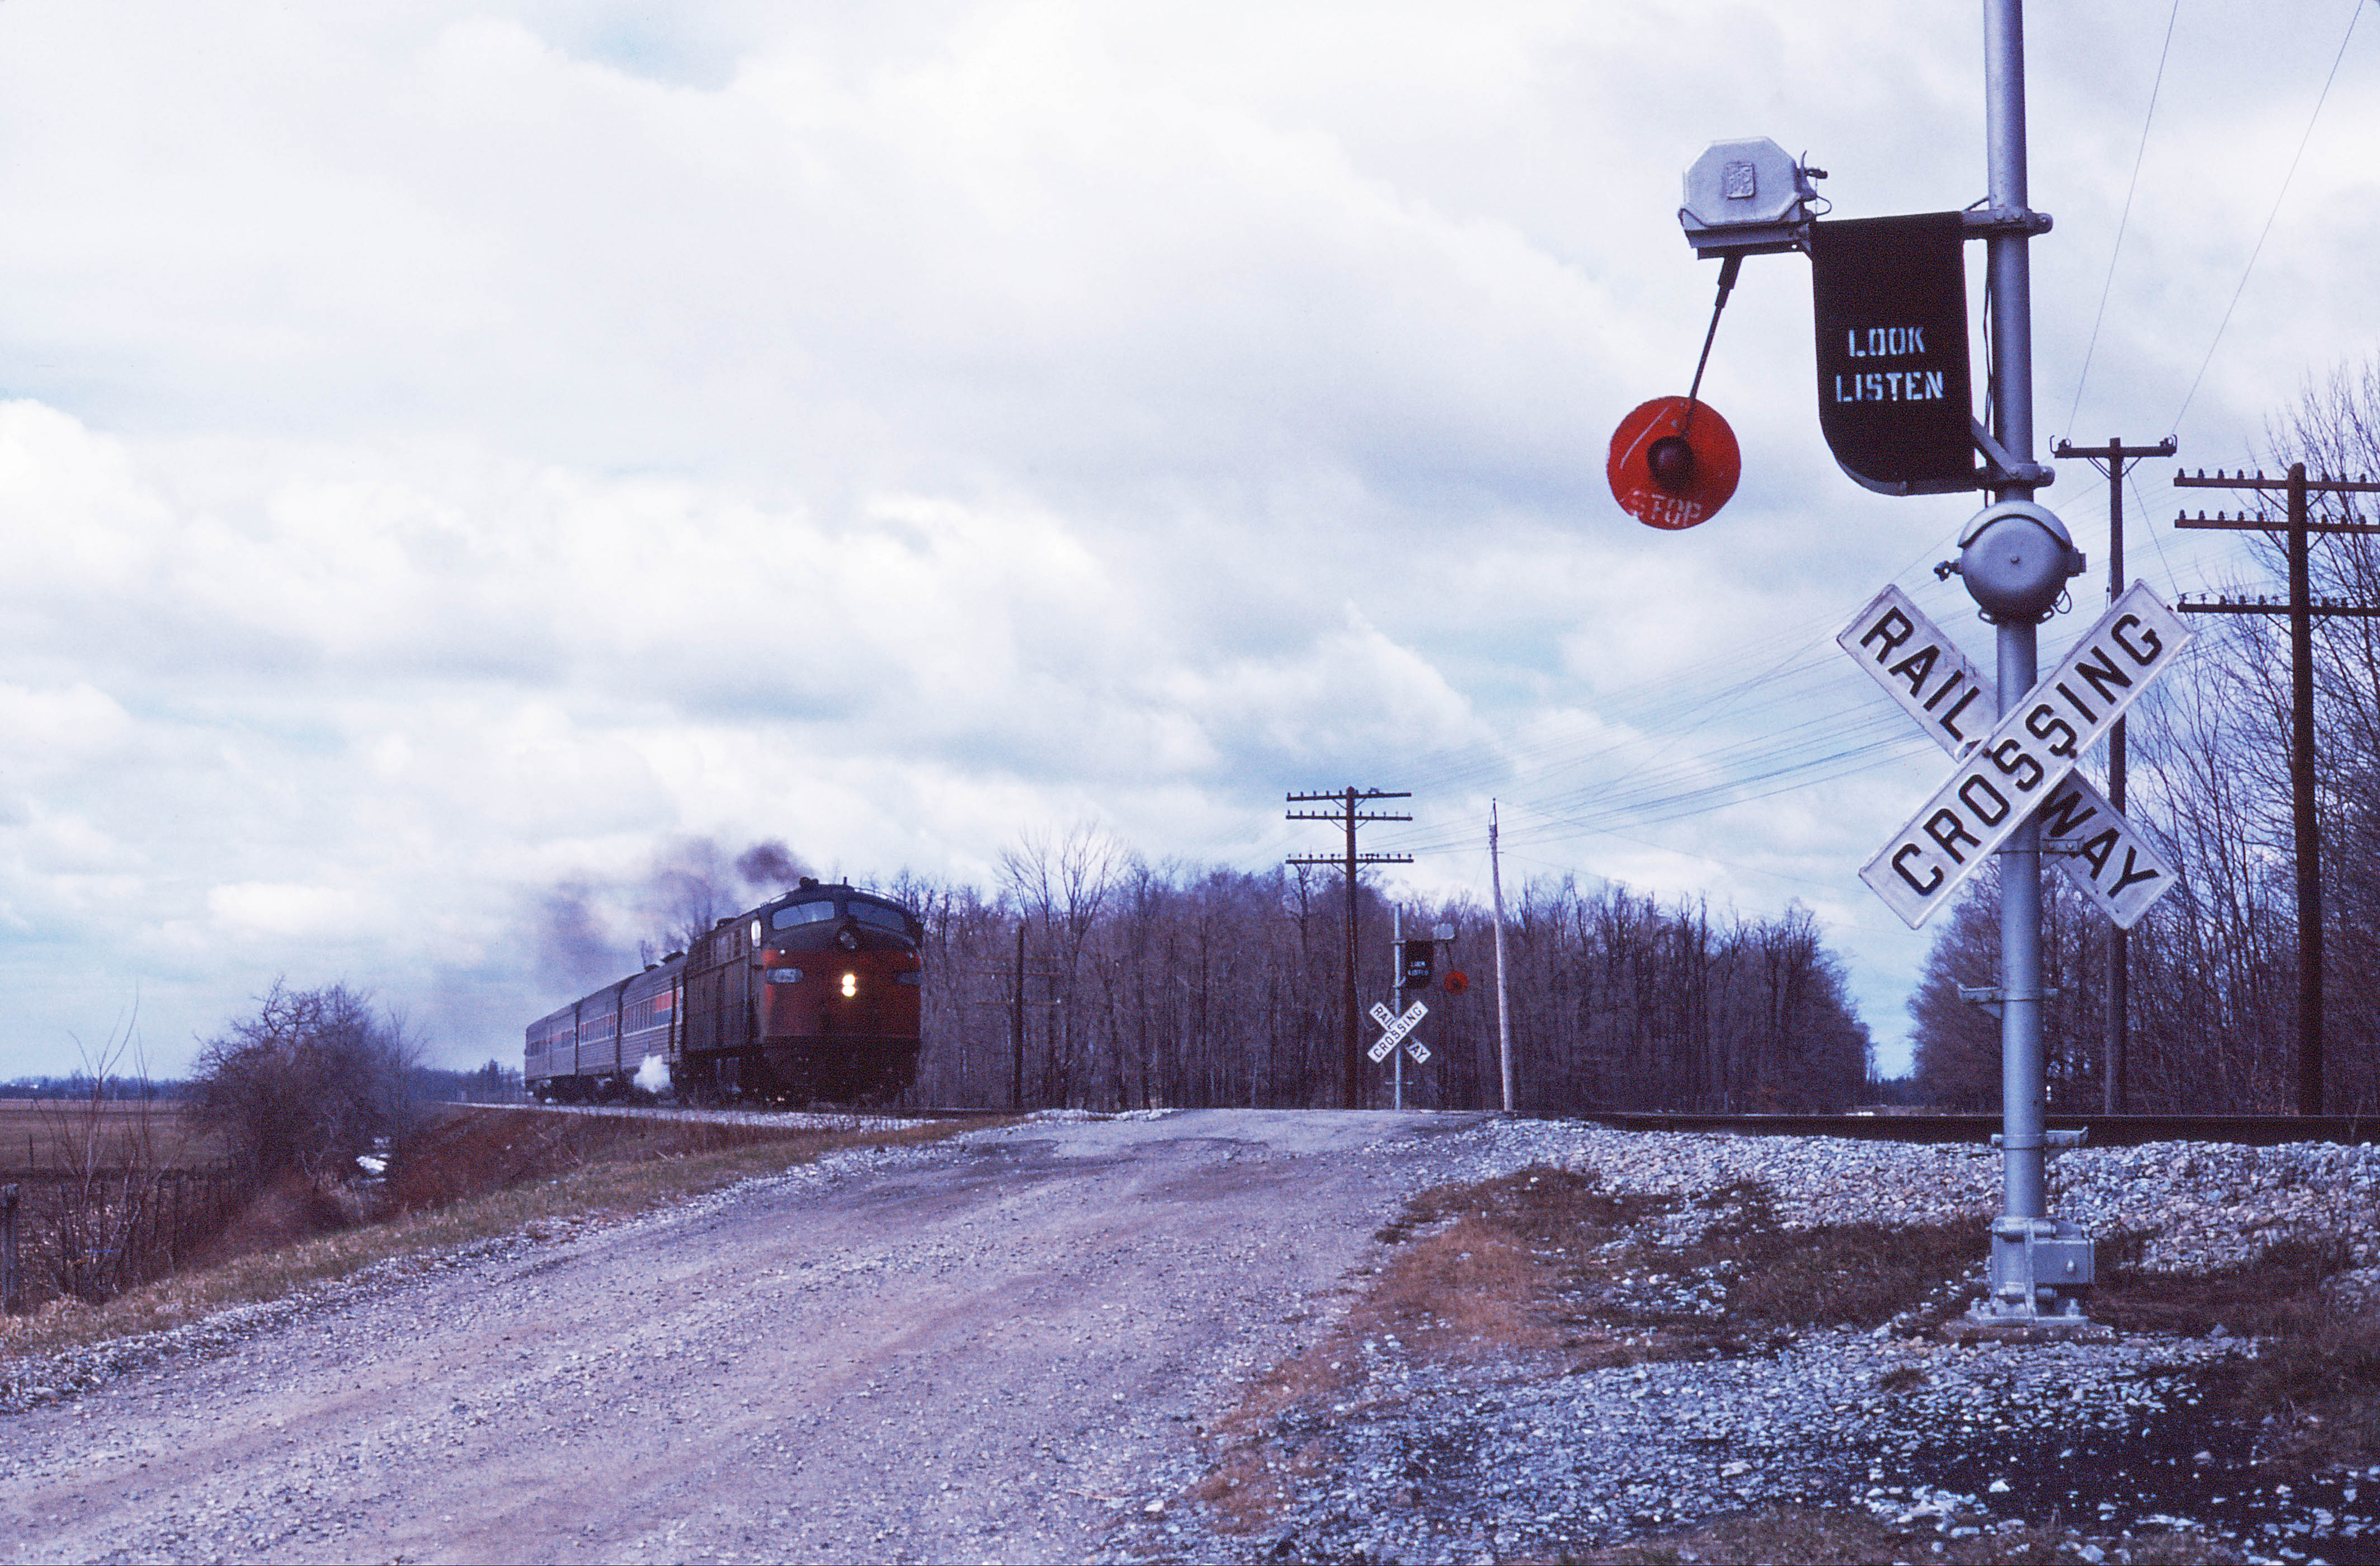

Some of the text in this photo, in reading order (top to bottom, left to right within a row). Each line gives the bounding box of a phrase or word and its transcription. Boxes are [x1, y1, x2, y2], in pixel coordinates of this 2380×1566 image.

[1849, 327, 1925, 357] LOOK
[1836, 371, 1944, 402] LISTEN
[1627, 490, 1702, 526] STOP
[1860, 606, 2160, 899] RAIL WAY
[1891, 614, 2163, 896] CROSSING
[1373, 1007, 1422, 1057] CROSSING
[1374, 1007, 1395, 1029] RAIL
